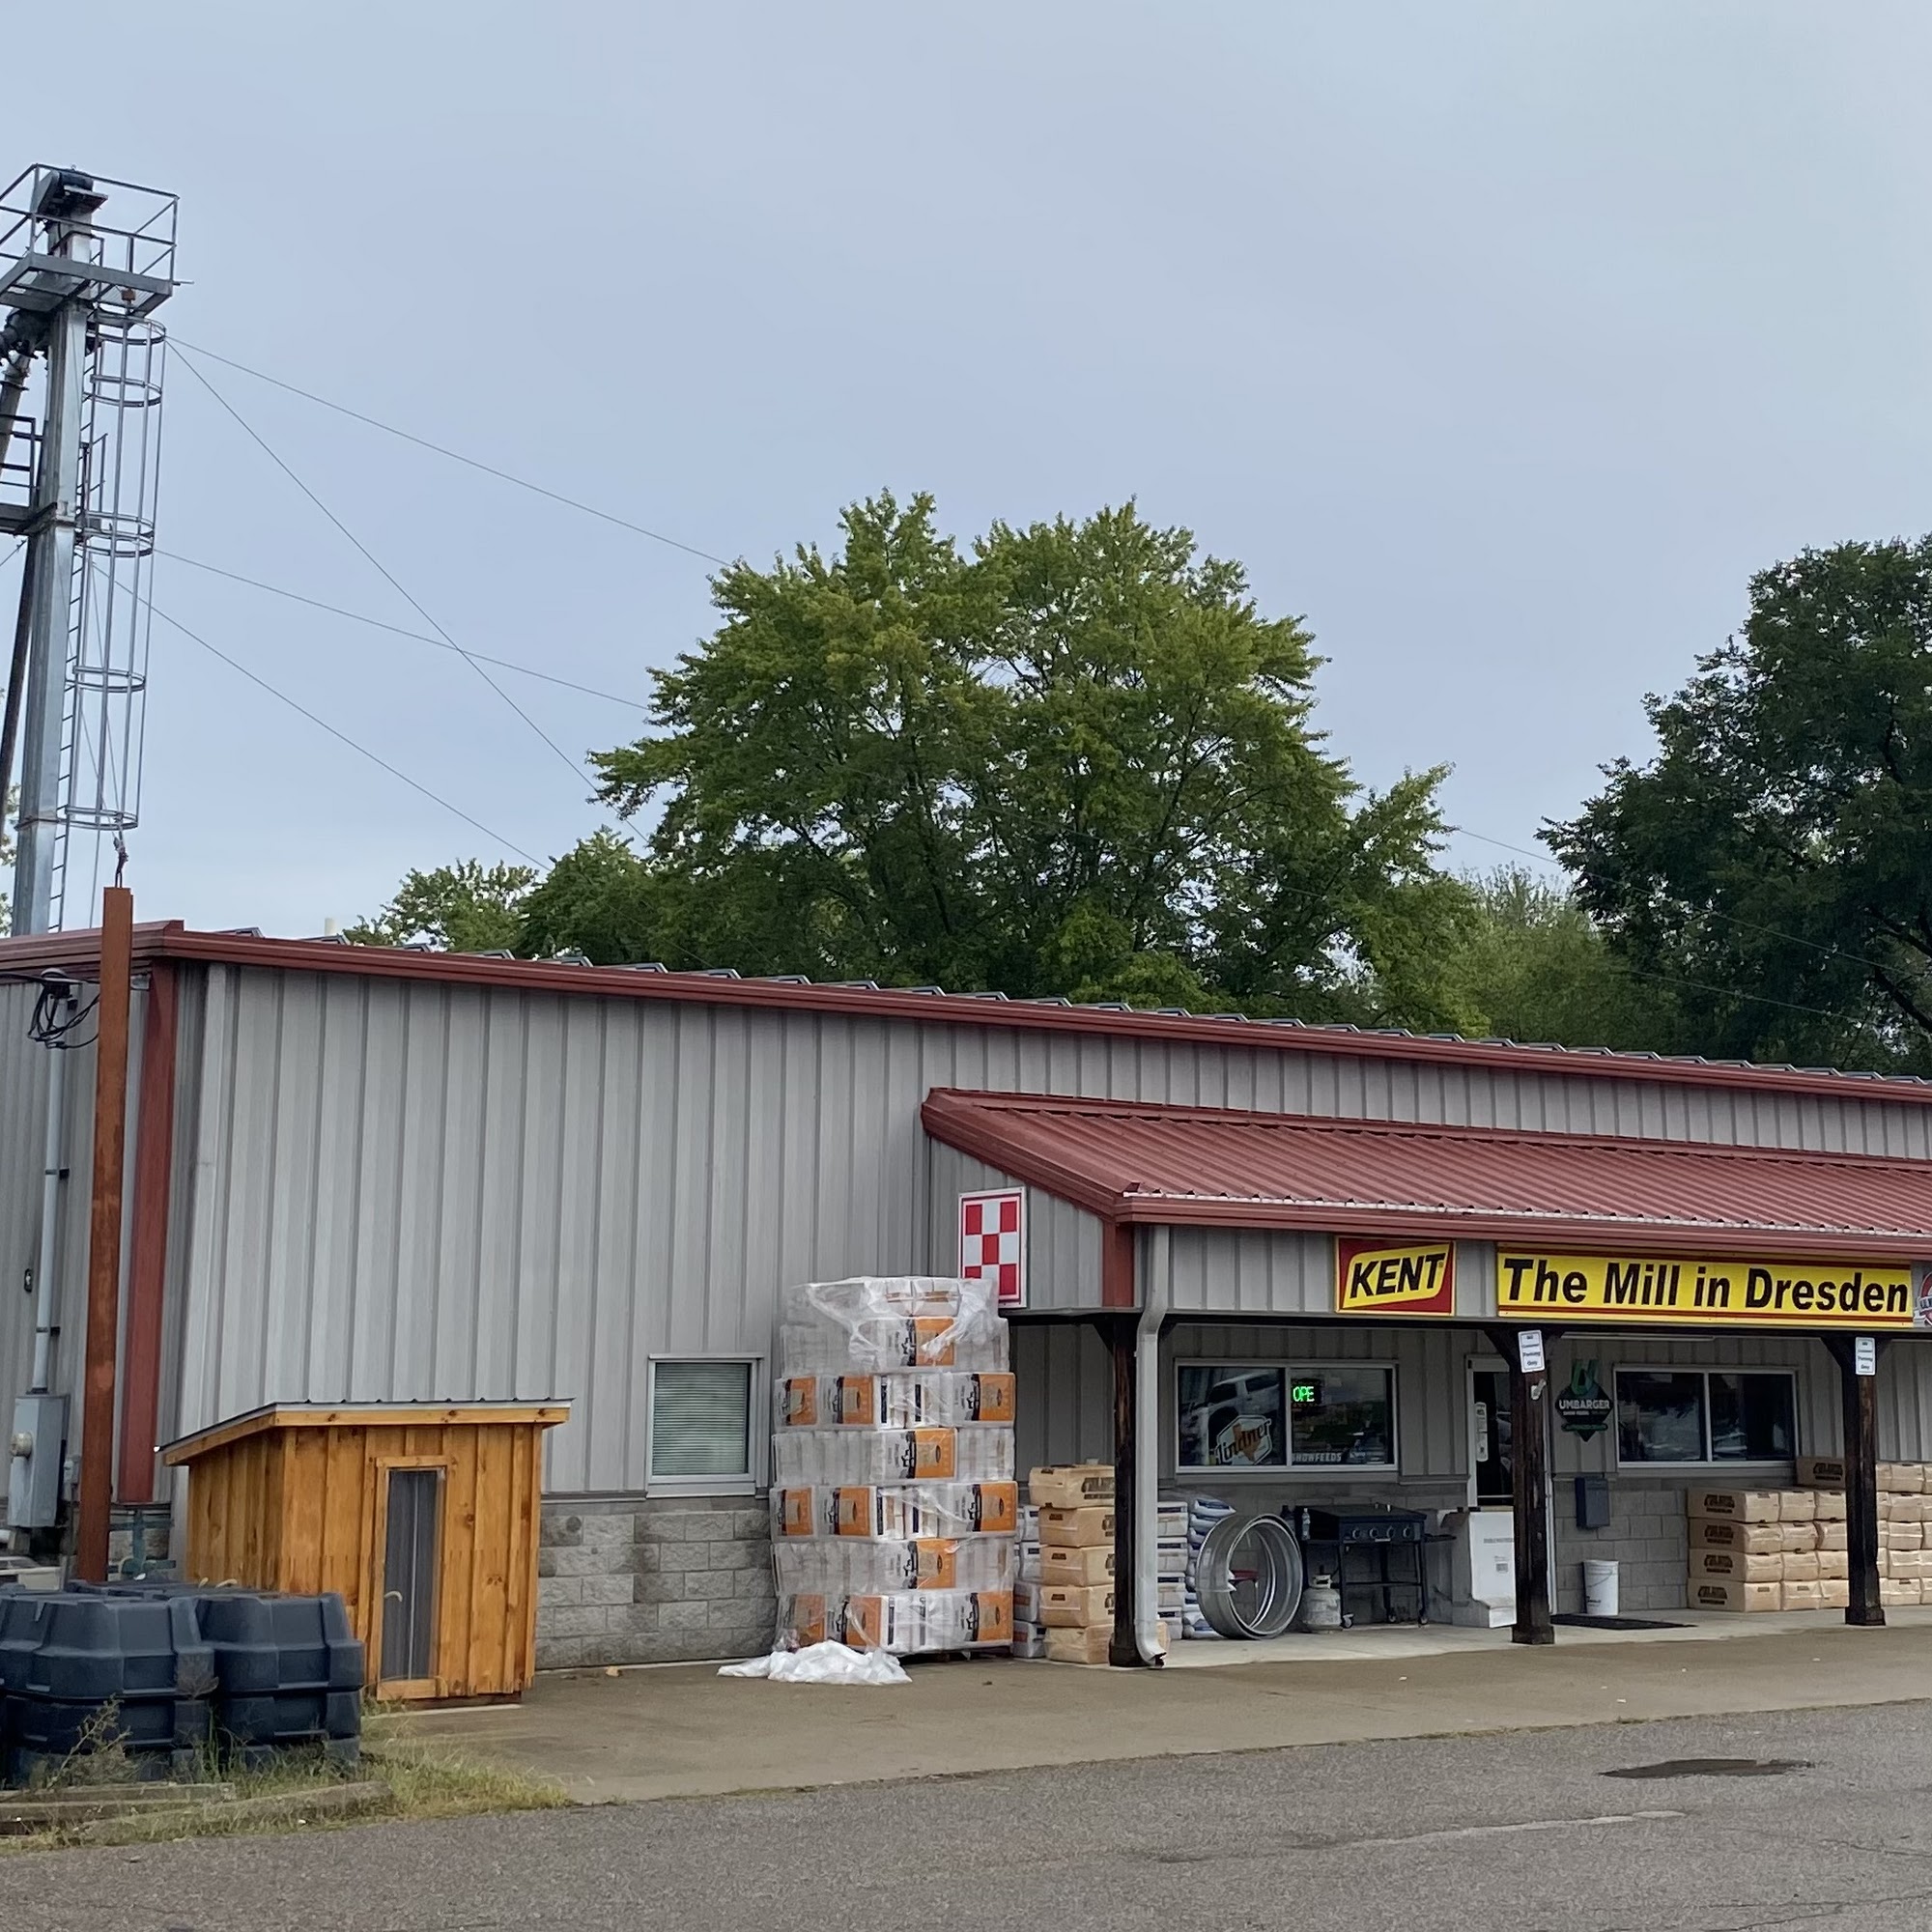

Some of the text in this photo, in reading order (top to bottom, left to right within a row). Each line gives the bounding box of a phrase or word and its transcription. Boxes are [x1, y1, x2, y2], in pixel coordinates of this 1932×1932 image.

[1350, 1252, 1446, 1299] KENT
[1503, 1258, 1908, 1312] The Mill in Dresden
[1558, 1399, 1610, 1409] UMBARGER
